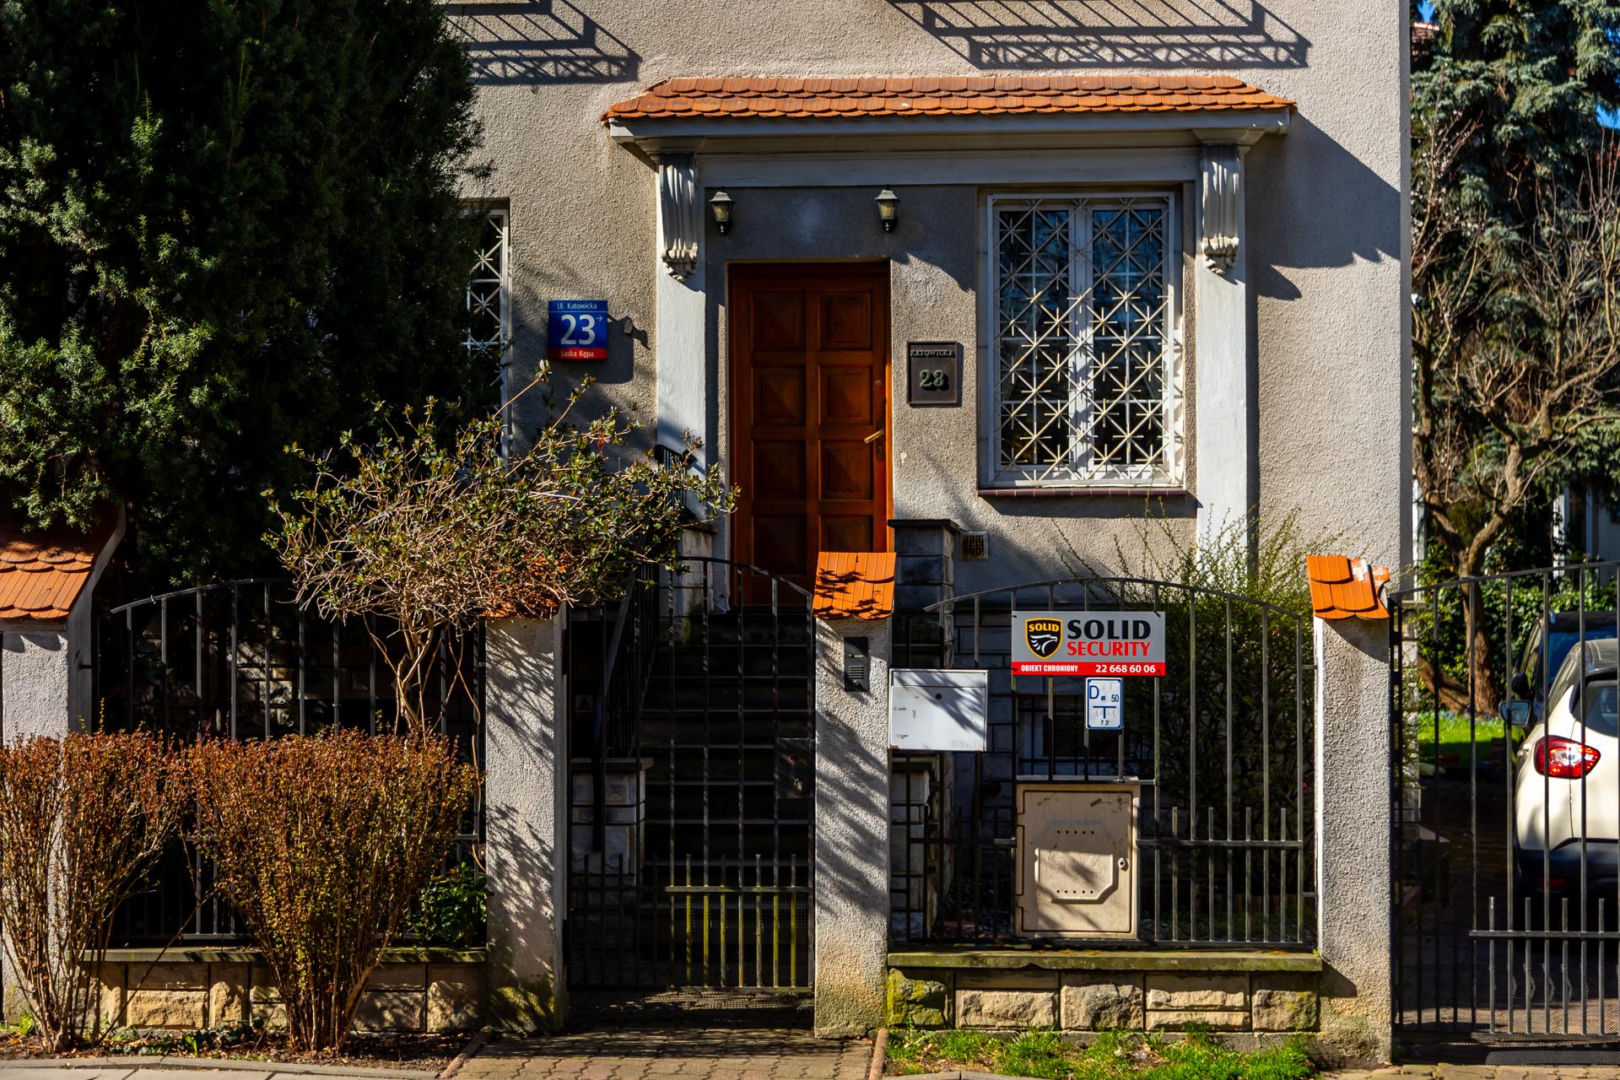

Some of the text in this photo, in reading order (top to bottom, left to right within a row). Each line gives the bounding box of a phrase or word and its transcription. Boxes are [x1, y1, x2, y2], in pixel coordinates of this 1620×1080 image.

[567, 302, 598, 310] Katowicka
[560, 314, 596, 345] 23
[910, 349, 953, 357] KATOWICKA
[919, 369, 945, 388] 23
[1028, 623, 1060, 632] SOLID
[1067, 619, 1151, 640] SOLID
[1066, 641, 1151, 656] SECURITY
[1020, 664, 1156, 673] OBIEKT CHRONIONY 22 668 60 06
[1111, 694, 1120, 702] 50
